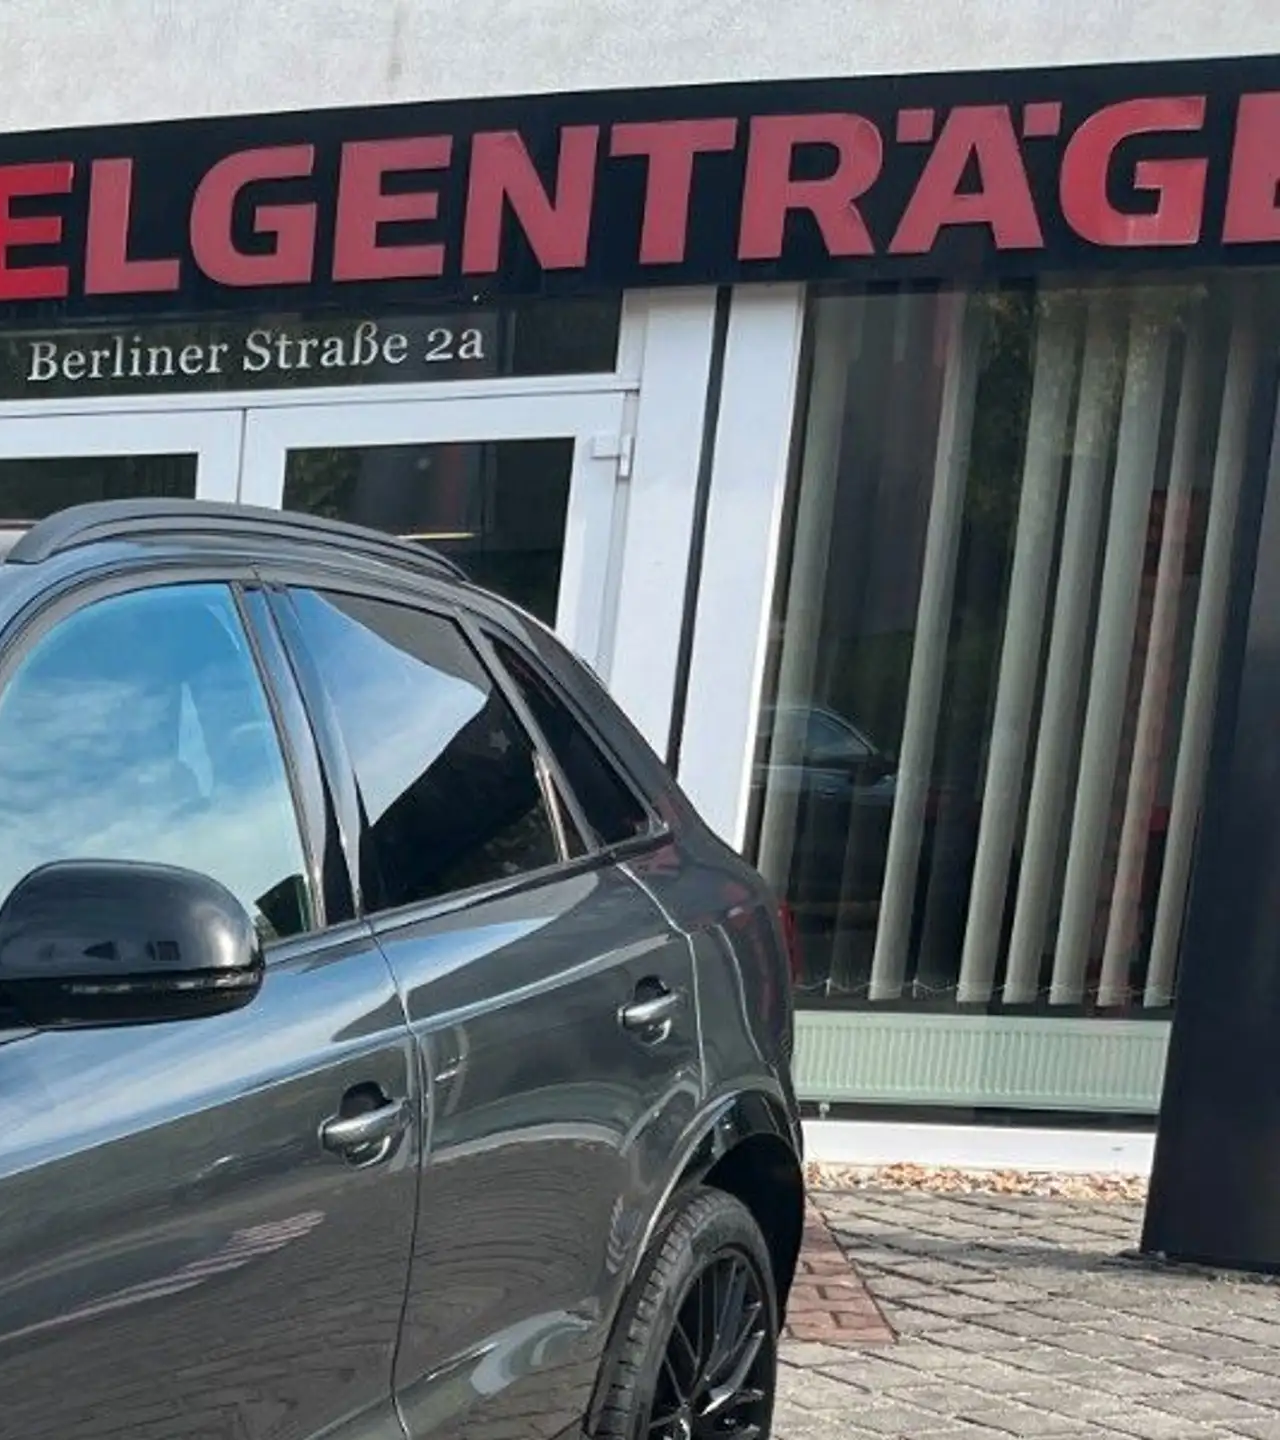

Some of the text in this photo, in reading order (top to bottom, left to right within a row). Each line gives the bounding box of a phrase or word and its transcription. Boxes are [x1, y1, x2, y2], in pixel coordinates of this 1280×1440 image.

[27, 321, 484, 381] Berliner Straße 2a
